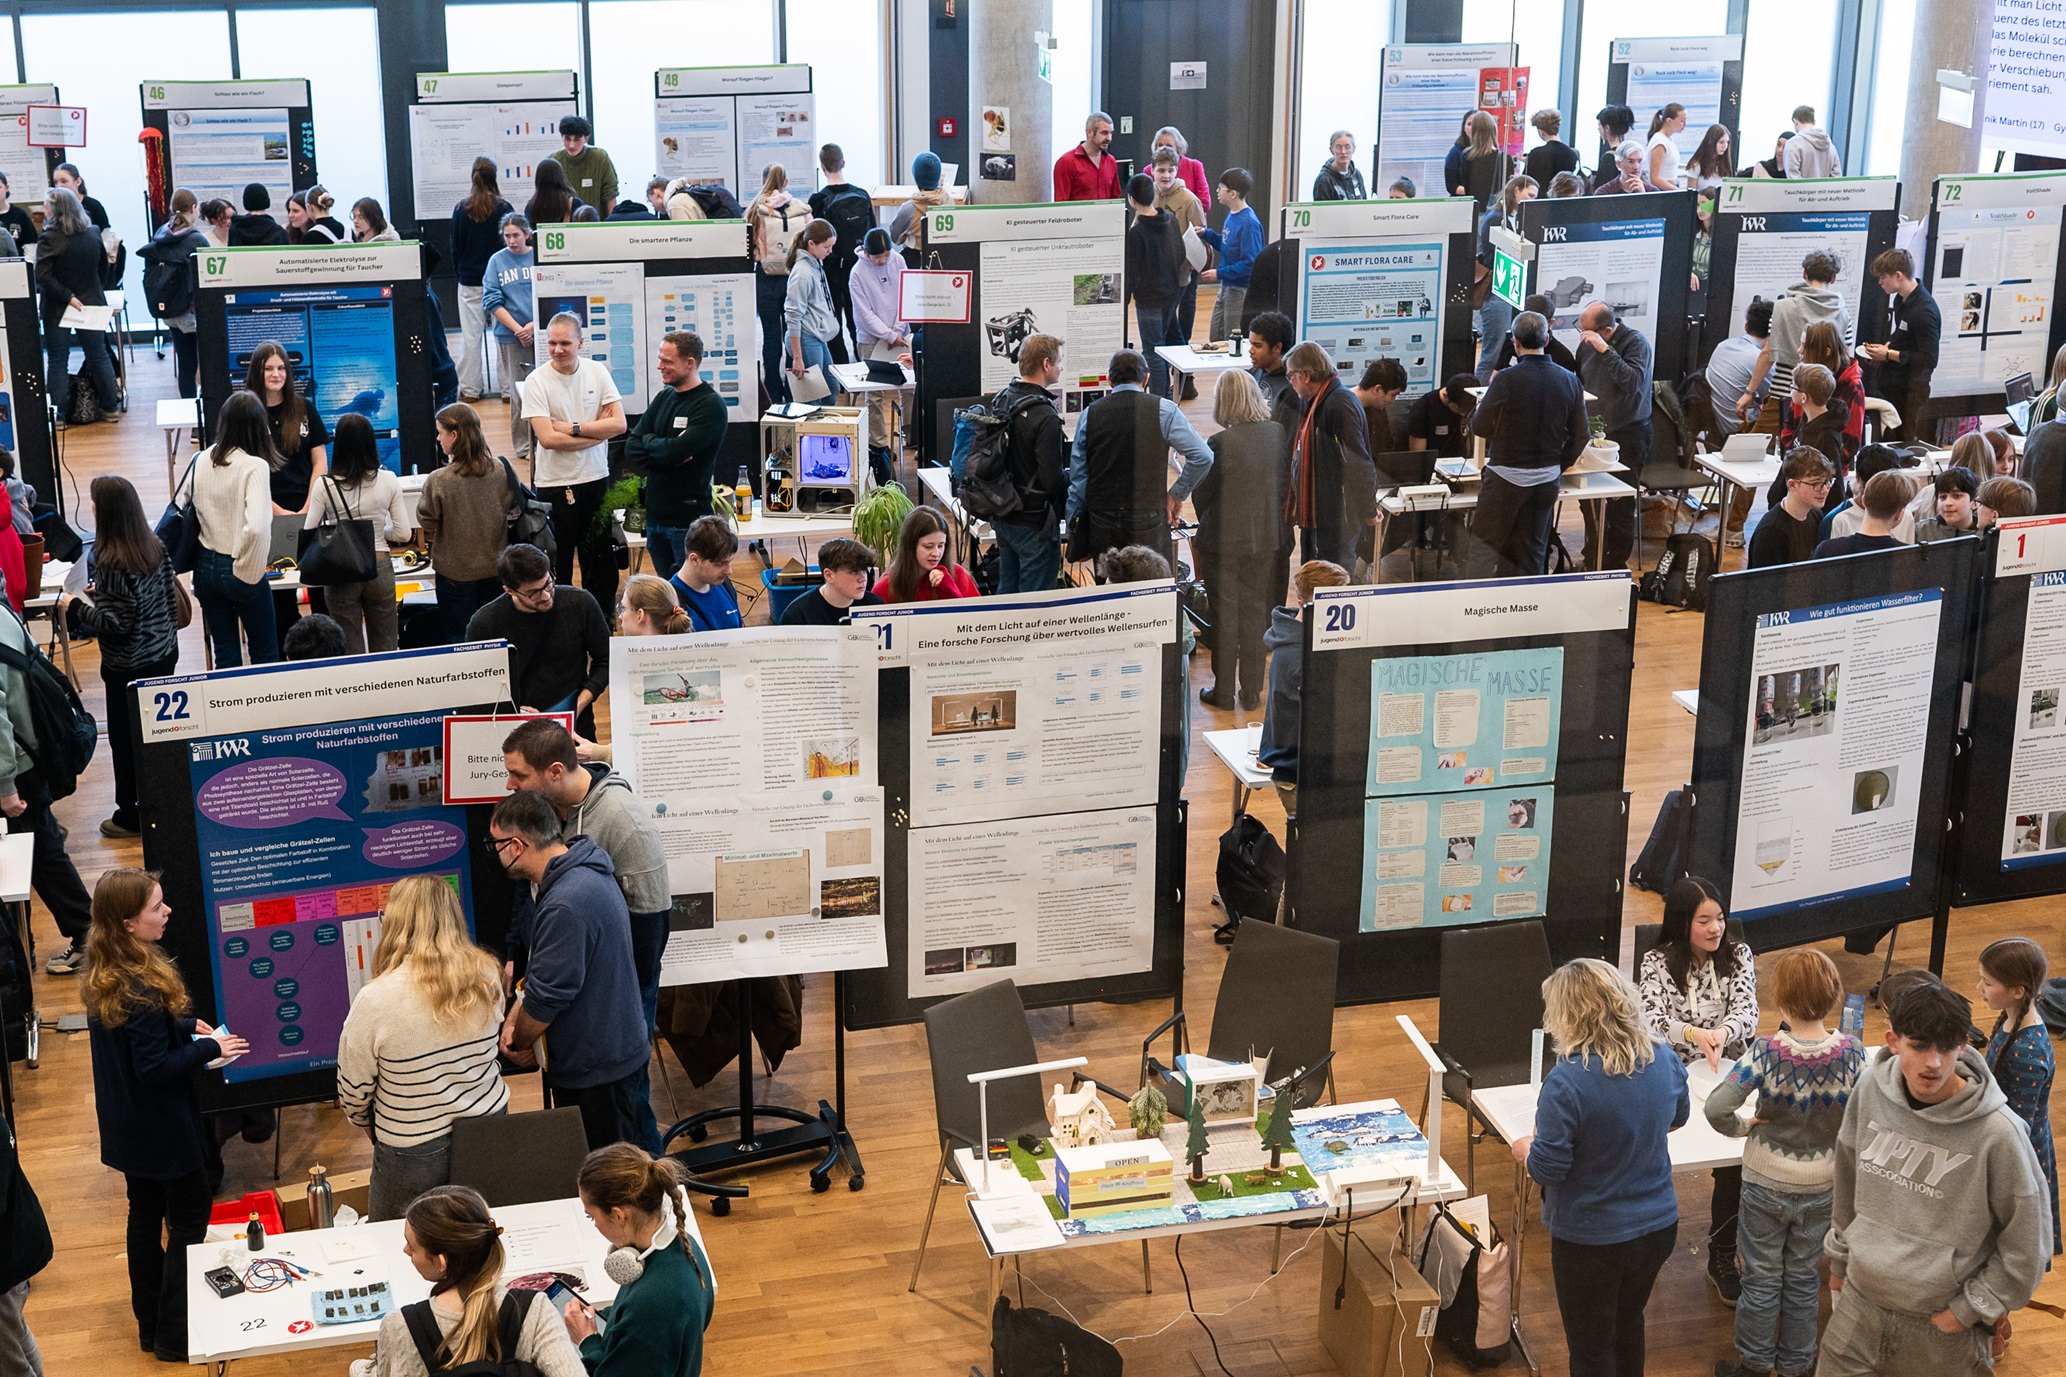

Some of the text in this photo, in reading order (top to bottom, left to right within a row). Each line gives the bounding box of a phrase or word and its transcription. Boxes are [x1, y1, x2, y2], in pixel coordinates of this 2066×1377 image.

[2036, 0, 2062, 11] Licht
[2021, 17, 2039, 26] des
[2009, 31, 2049, 44] Molekül
[1390, 50, 1402, 62] 53
[1618, 43, 1630, 55] 52
[2009, 48, 2065, 62] berechnen
[664, 74, 678, 86] 48
[2000, 64, 2066, 81] Verschiebun
[150, 87, 164, 100] 46
[424, 80, 438, 93] 47
[1988, 79, 2052, 94] riement sah.
[1999, 117, 2028, 128] Martin
[2030, 120, 2045, 130] (17)
[1729, 186, 1743, 201] 71
[1945, 185, 1962, 200] 72
[935, 214, 954, 232] 69
[1293, 210, 1311, 227] 70
[1742, 216, 1766, 231] KWR
[546, 232, 565, 250] 68
[669, 236, 693, 244] Pflanze
[1543, 227, 1566, 242] KWR
[206, 256, 226, 275] 67
[329, 256, 366, 265] Elektrolyse
[1335, 256, 1414, 267] SMART FLORA CARE
[275, 265, 345, 274] Sauerstoffgewinnung
[498, 268, 518, 286] SAN
[596, 278, 613, 286] Pflanze
[2018, 533, 2026, 558] 1
[1464, 602, 1539, 618] Magische Masse
[1809, 593, 1923, 619] Wie gut funktionieren Wasserfilter?
[956, 611, 1126, 633] Mit dem Licht auf einer Wellenlänge
[1326, 603, 1356, 632] 20
[1769, 611, 1790, 627] KWR
[918, 618, 1168, 649] Eine forsche Forschung über wertvolles Wellensurfen
[1378, 656, 1552, 696] MAGISCHE MASSE
[209, 667, 505, 709] Strom produzieren mit verschiedenen Naturfarbstoffen
[154, 691, 190, 722] 22
[262, 715, 443, 744] Strom produzieren mit verschiedene
[316, 732, 398, 749] Naturfarbstoffen
[213, 738, 251, 760] KWR
[258, 763, 292, 772] Grätzel-Zelle
[470, 770, 508, 779] Jury-Ges
[254, 842, 288, 852] vergleiche
[290, 836, 336, 848] Grätzel-Zellen
[761, 850, 798, 859] Maximalwerte
[1115, 1158, 1139, 1166] OPEN
[240, 1317, 268, 1333] 22
